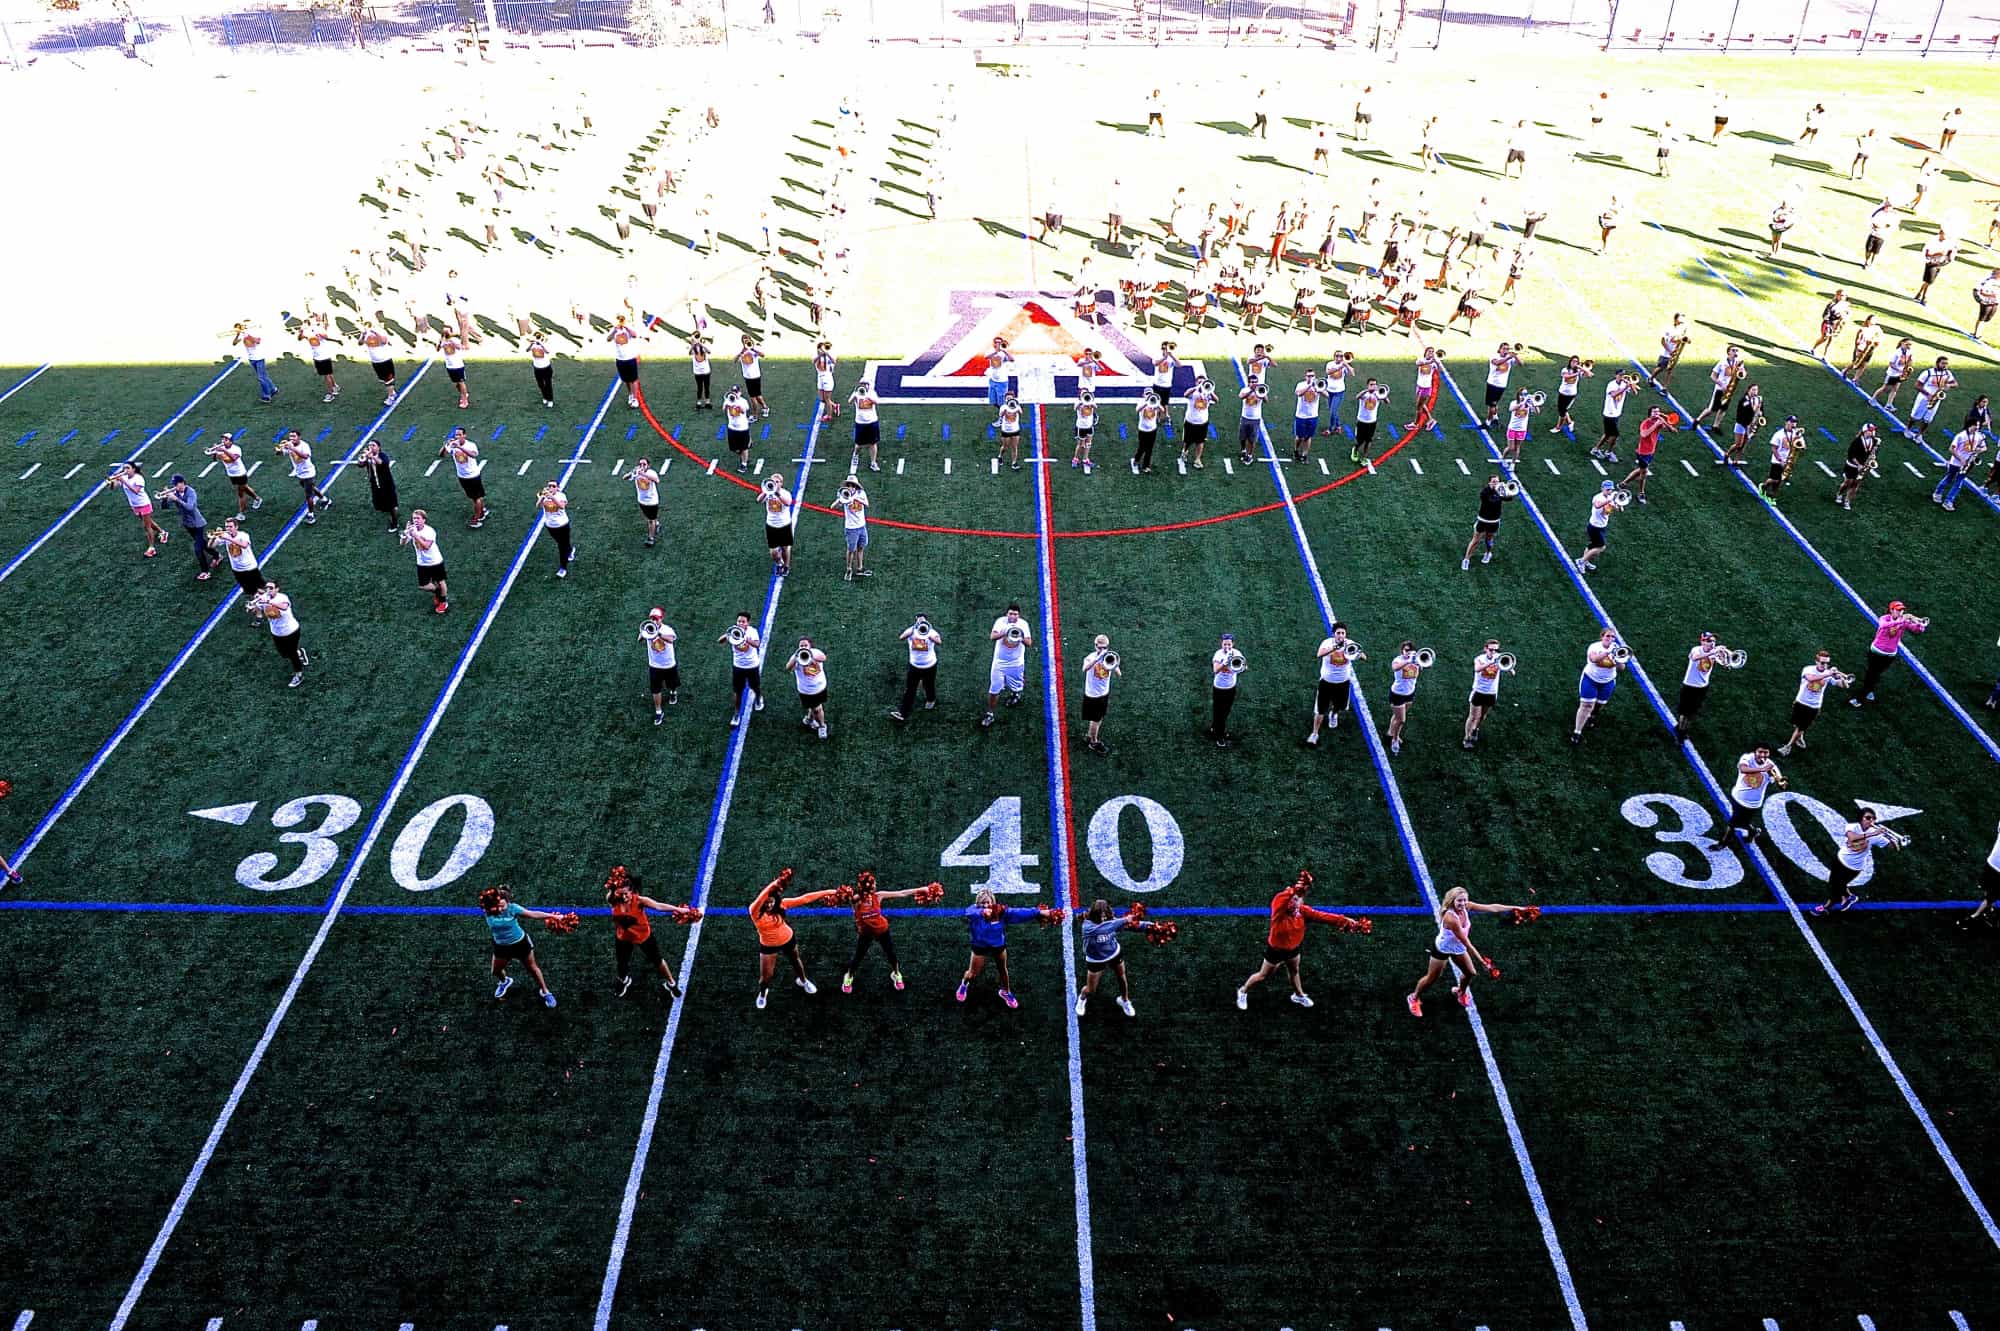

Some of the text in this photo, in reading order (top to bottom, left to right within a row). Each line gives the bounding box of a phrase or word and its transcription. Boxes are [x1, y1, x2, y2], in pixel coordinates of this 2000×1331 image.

[866, 290, 1211, 404] A
[235, 794, 495, 891] 30
[940, 795, 1184, 894] 40
[1620, 792, 1875, 889] 30
